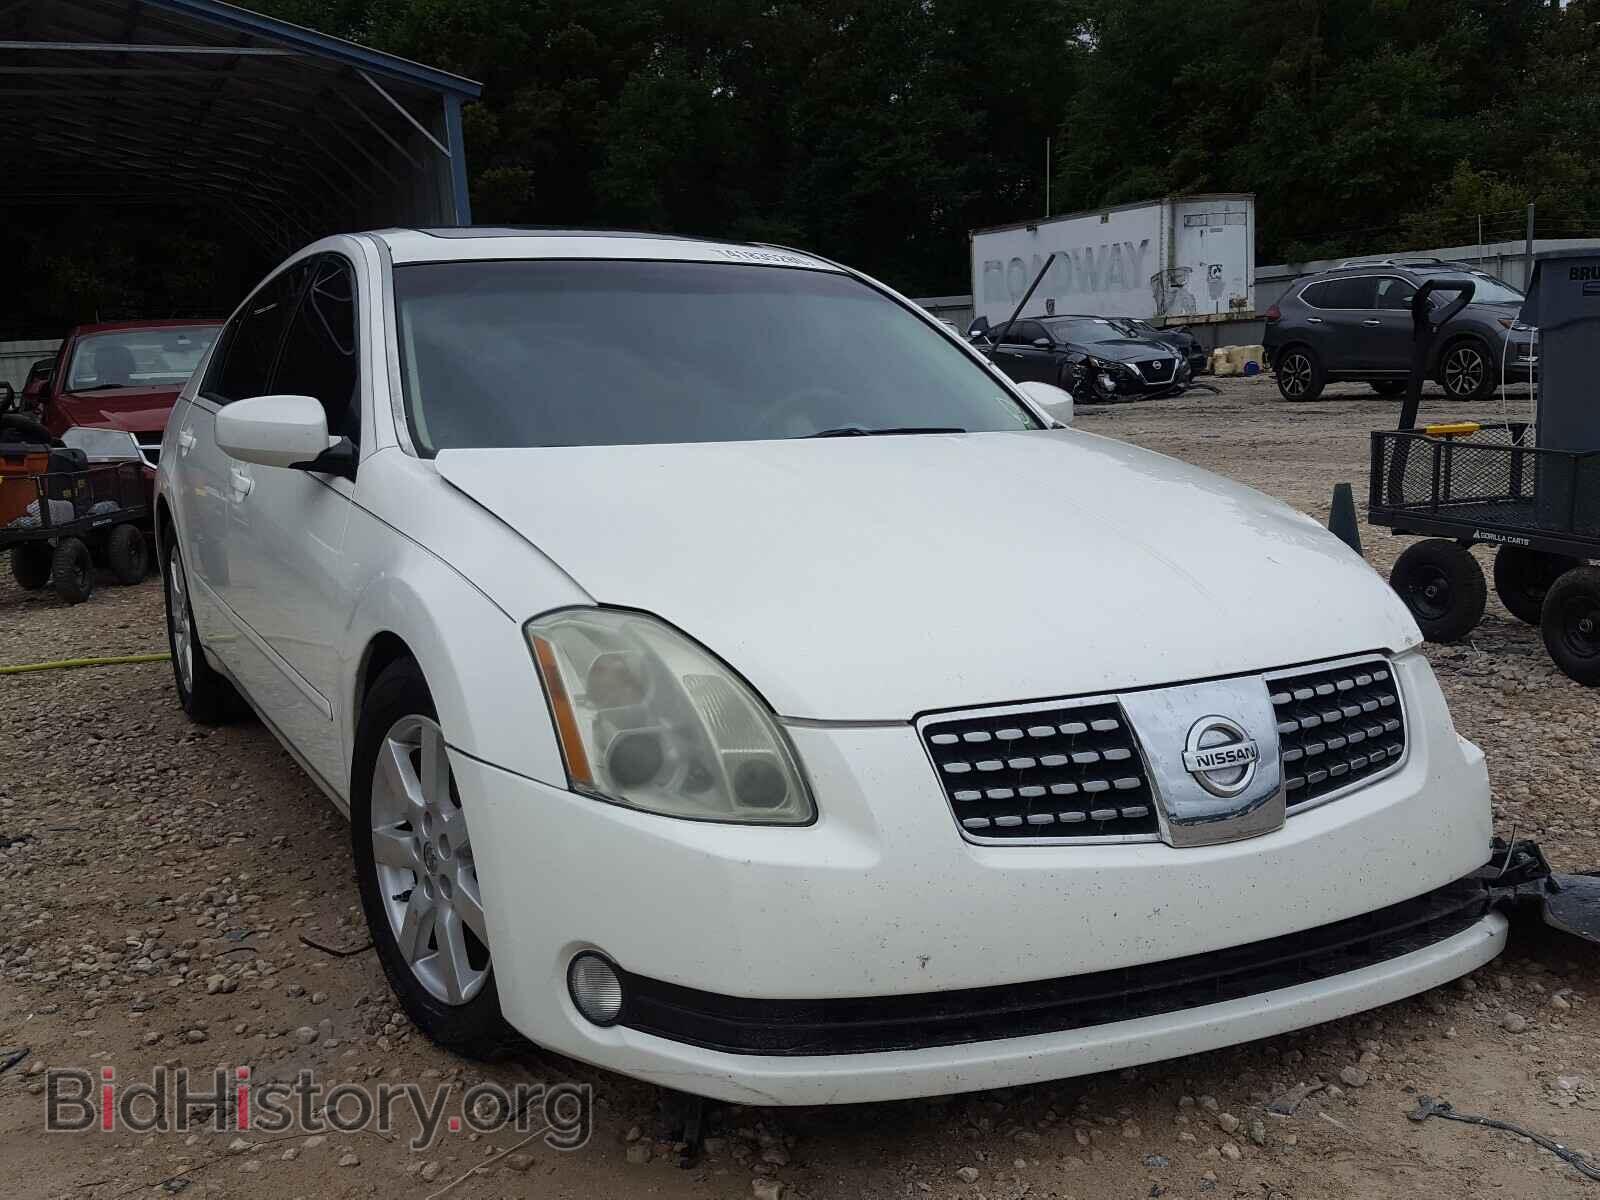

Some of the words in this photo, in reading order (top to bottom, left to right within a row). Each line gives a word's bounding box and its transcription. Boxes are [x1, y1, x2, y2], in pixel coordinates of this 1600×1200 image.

[1480, 532, 1506, 542] GORILLA
[1507, 536, 1529, 546] CARTS
[1195, 746, 1256, 768] NISSAN
